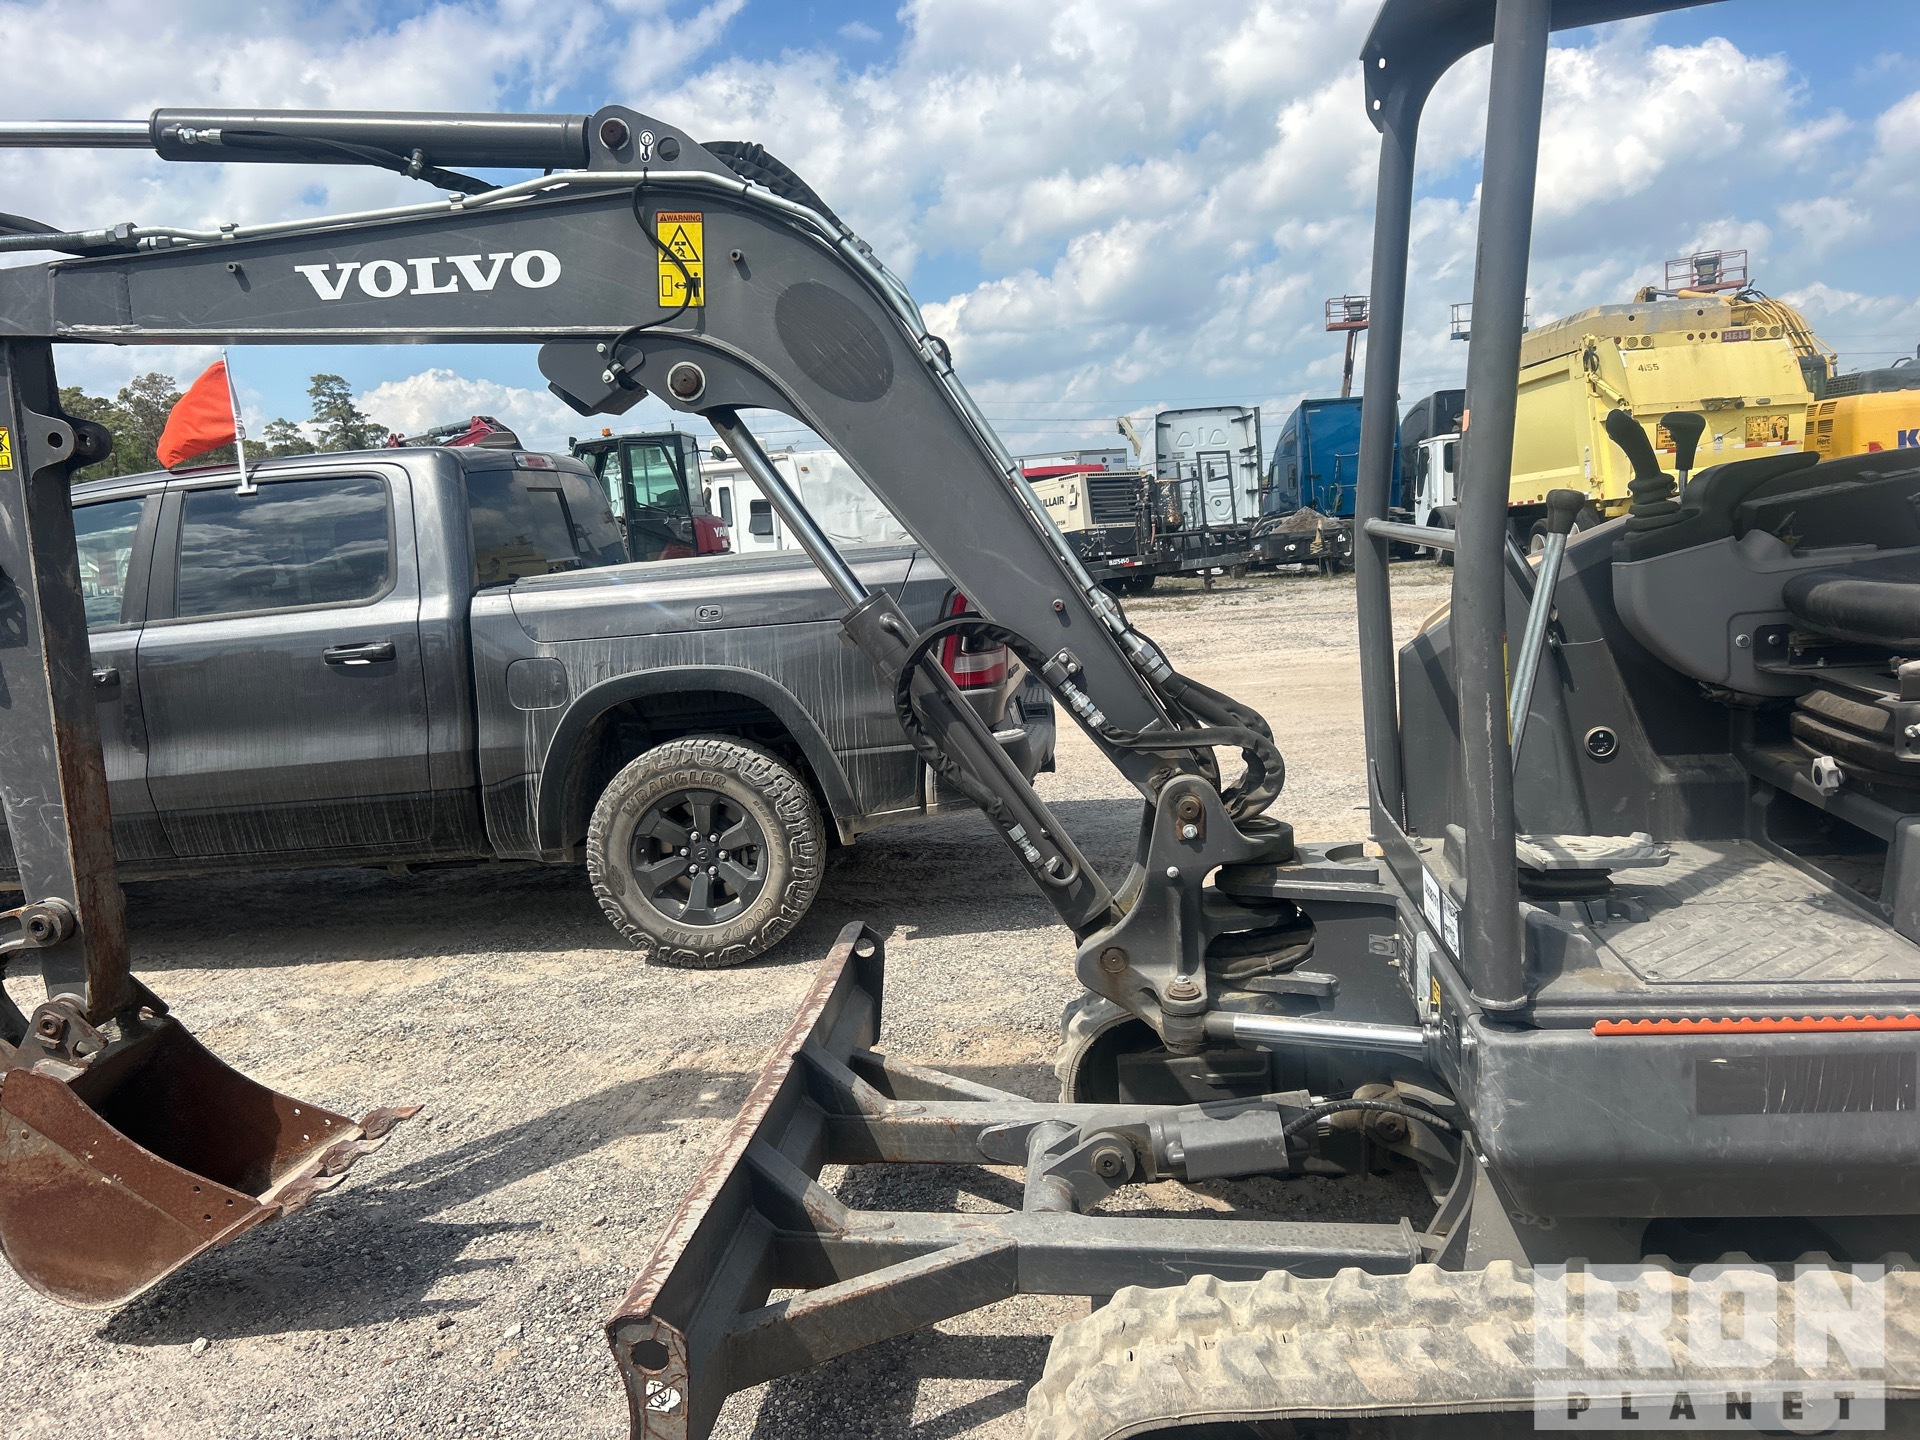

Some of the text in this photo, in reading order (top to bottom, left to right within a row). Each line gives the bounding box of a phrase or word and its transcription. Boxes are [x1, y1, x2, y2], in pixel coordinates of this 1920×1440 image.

[294, 249, 562, 301] VOLVO
[1724, 330, 1749, 340] HEIL
[1637, 363, 1660, 372] 4155
[1816, 437, 1831, 446] Herc
[1040, 495, 1065, 508] ULLAIR
[622, 770, 728, 818] WRANGLER
